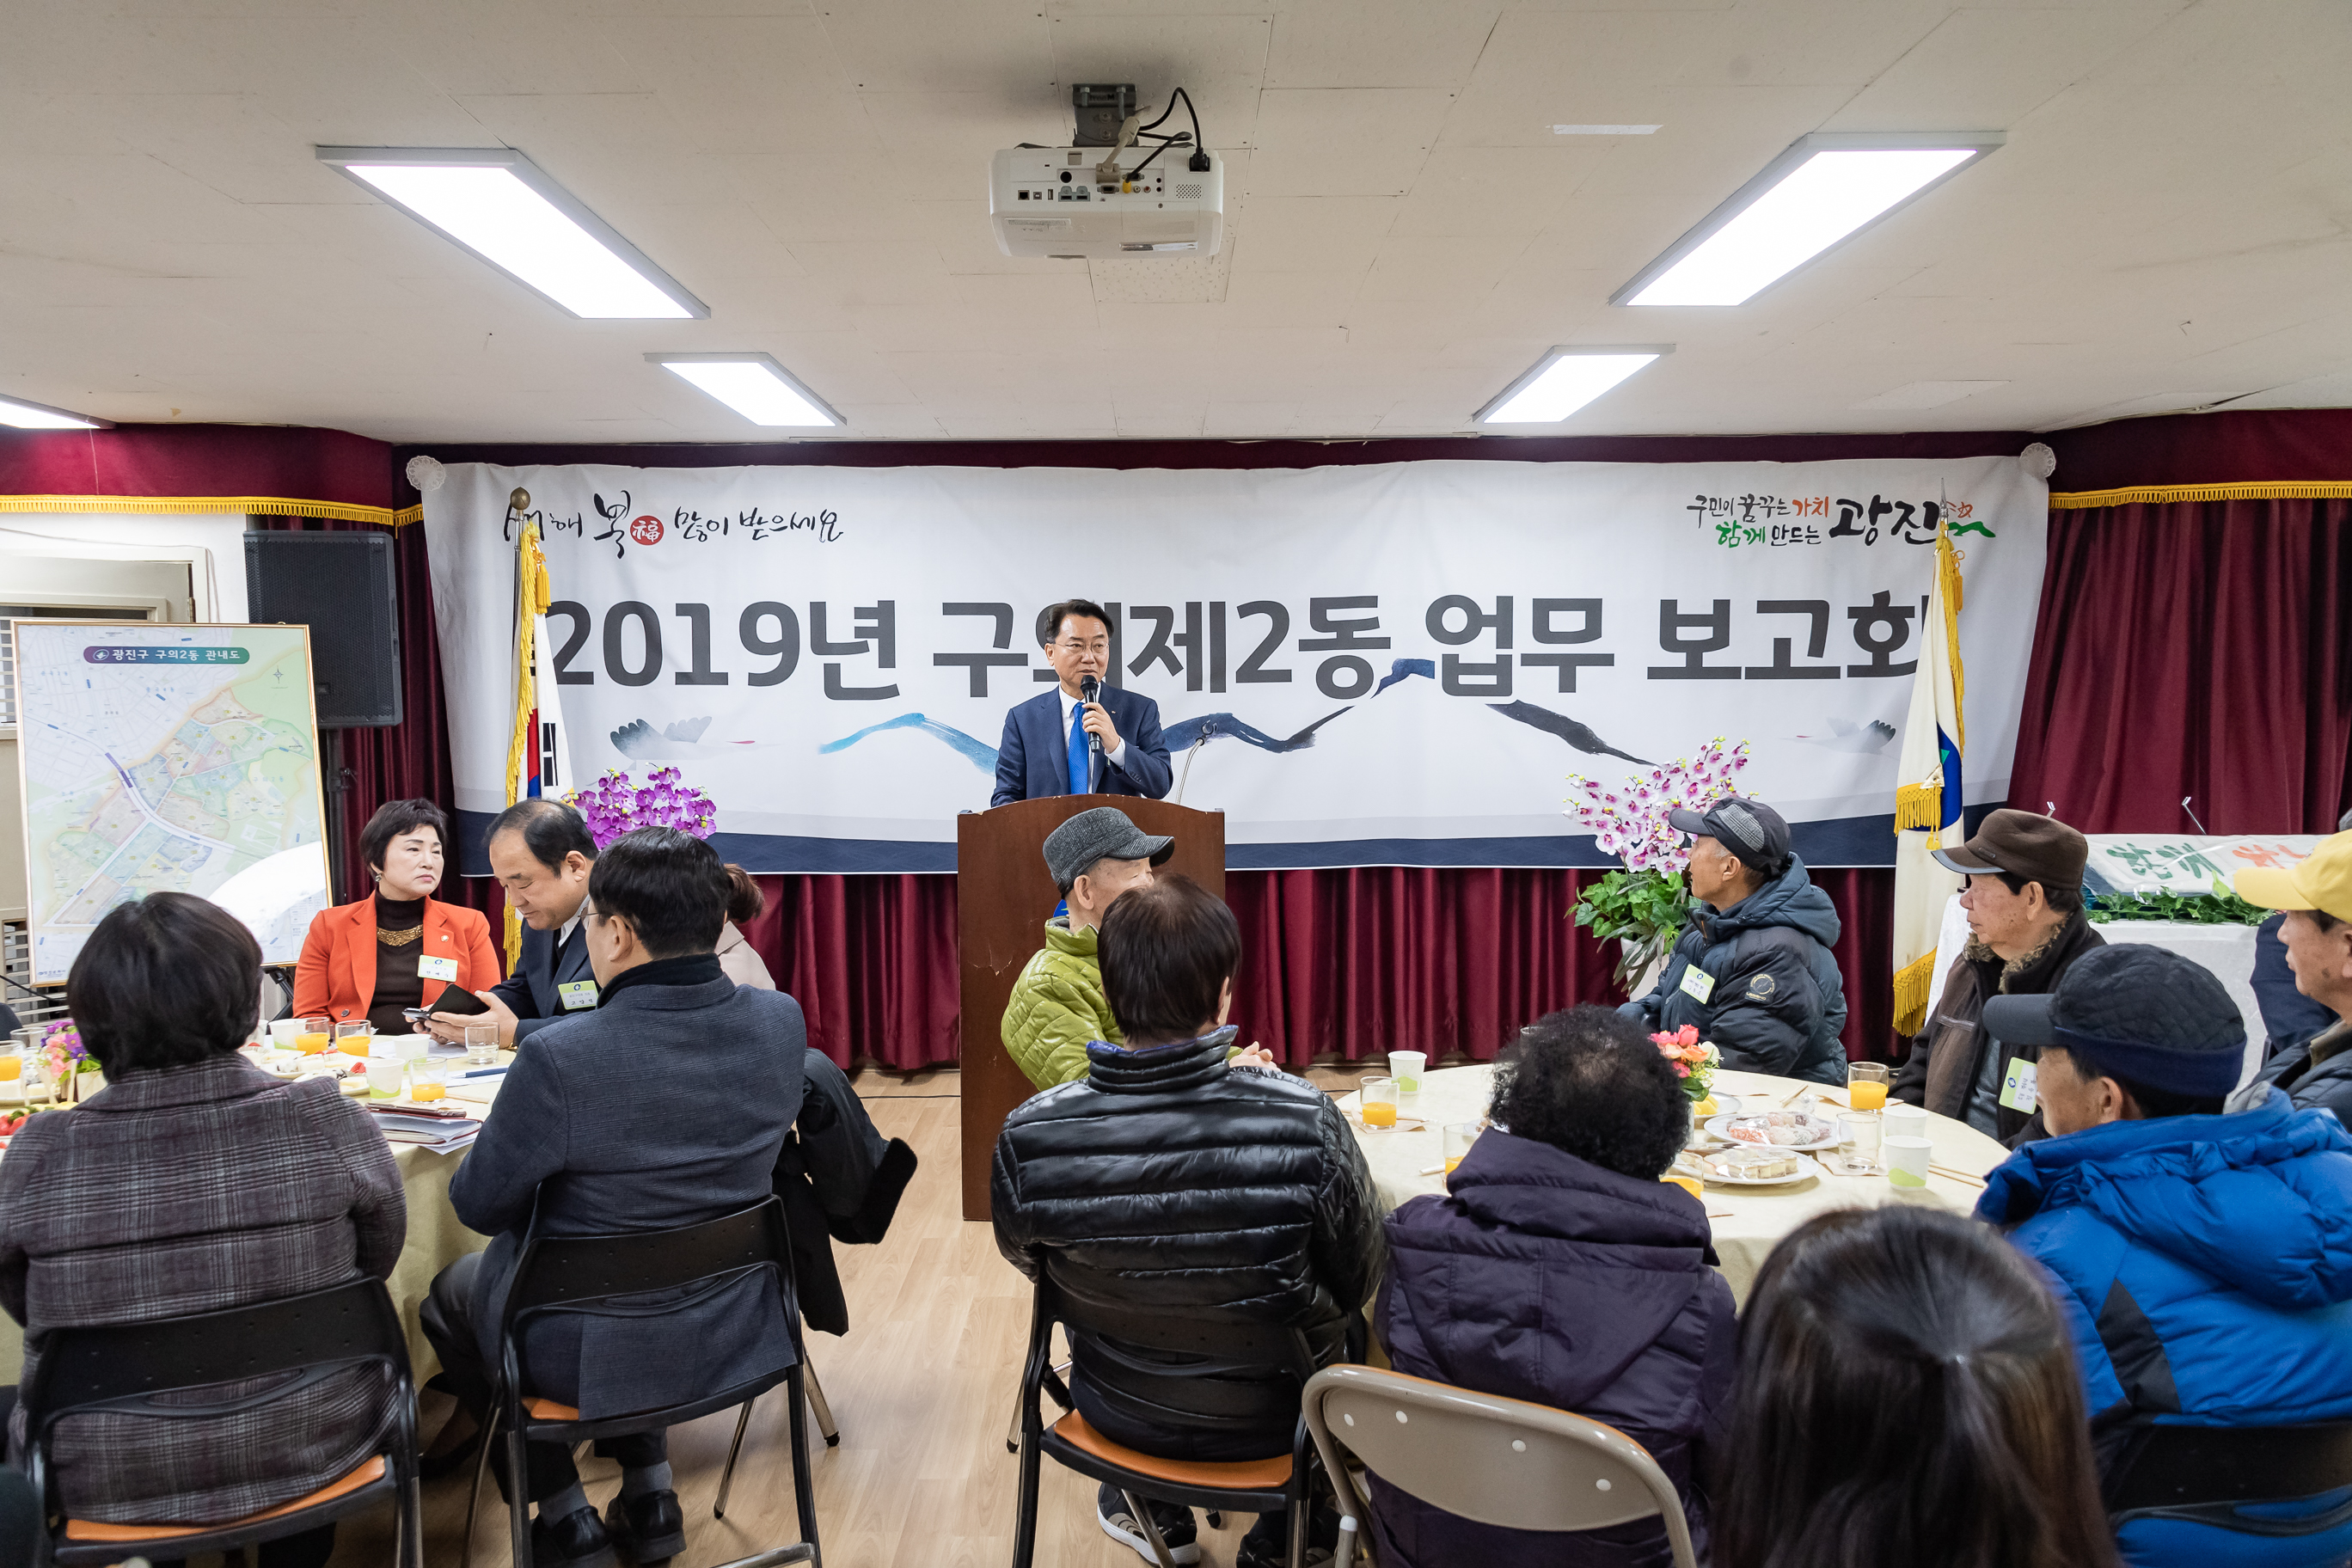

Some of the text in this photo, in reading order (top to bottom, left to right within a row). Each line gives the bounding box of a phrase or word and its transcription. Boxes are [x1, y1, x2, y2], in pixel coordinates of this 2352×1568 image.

[593, 489, 631, 560] 복
[674, 505, 729, 542] 많이
[739, 507, 844, 542] 받으세요
[1686, 493, 1829, 528] 구민이 꿈꾸는 가치
[1828, 494, 1940, 547] 광진
[1715, 519, 1822, 548] 함께 만드는
[112, 649, 241, 661] 광진구 구의2동 관내도
[543, 599, 900, 701] 2019년
[1424, 595, 1614, 697] 업무
